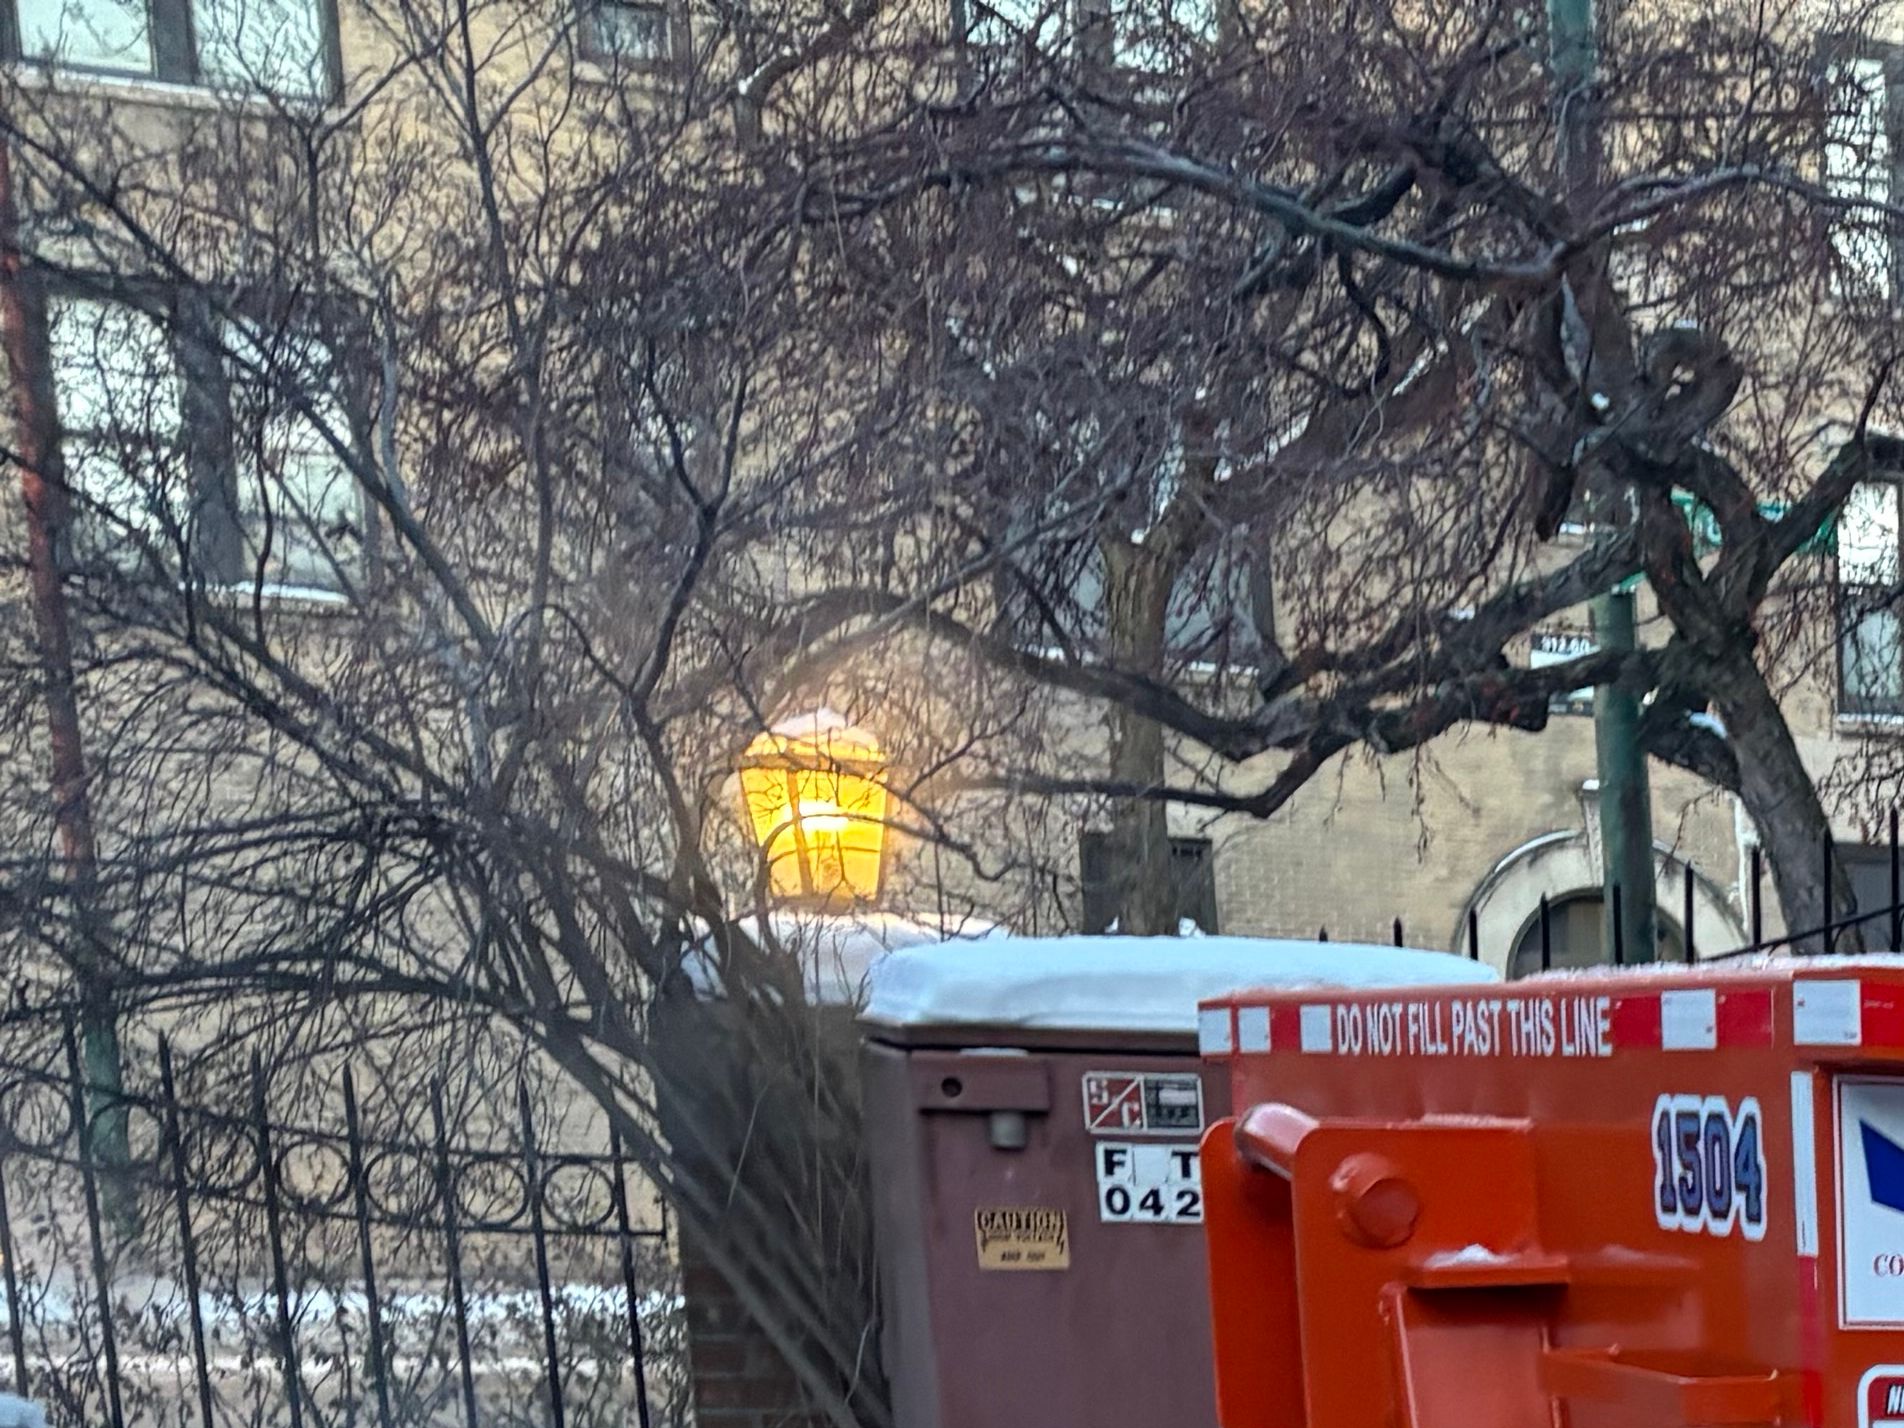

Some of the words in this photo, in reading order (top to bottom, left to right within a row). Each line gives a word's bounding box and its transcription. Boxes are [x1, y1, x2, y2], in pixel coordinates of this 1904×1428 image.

[1337, 1002, 1363, 1055] DO
[1367, 1002, 1403, 1056] NOT
[1408, 1001, 1448, 1056] FILL
[1451, 1000, 1501, 1056] PAST
[1506, 998, 1555, 1056] THIS
[1560, 996, 1613, 1057] LINE
[1103, 1149, 1127, 1177] F
[1171, 1152, 1200, 1179] T
[1655, 1102, 1764, 1232] 1504
[1105, 1186, 1200, 1217] 042
